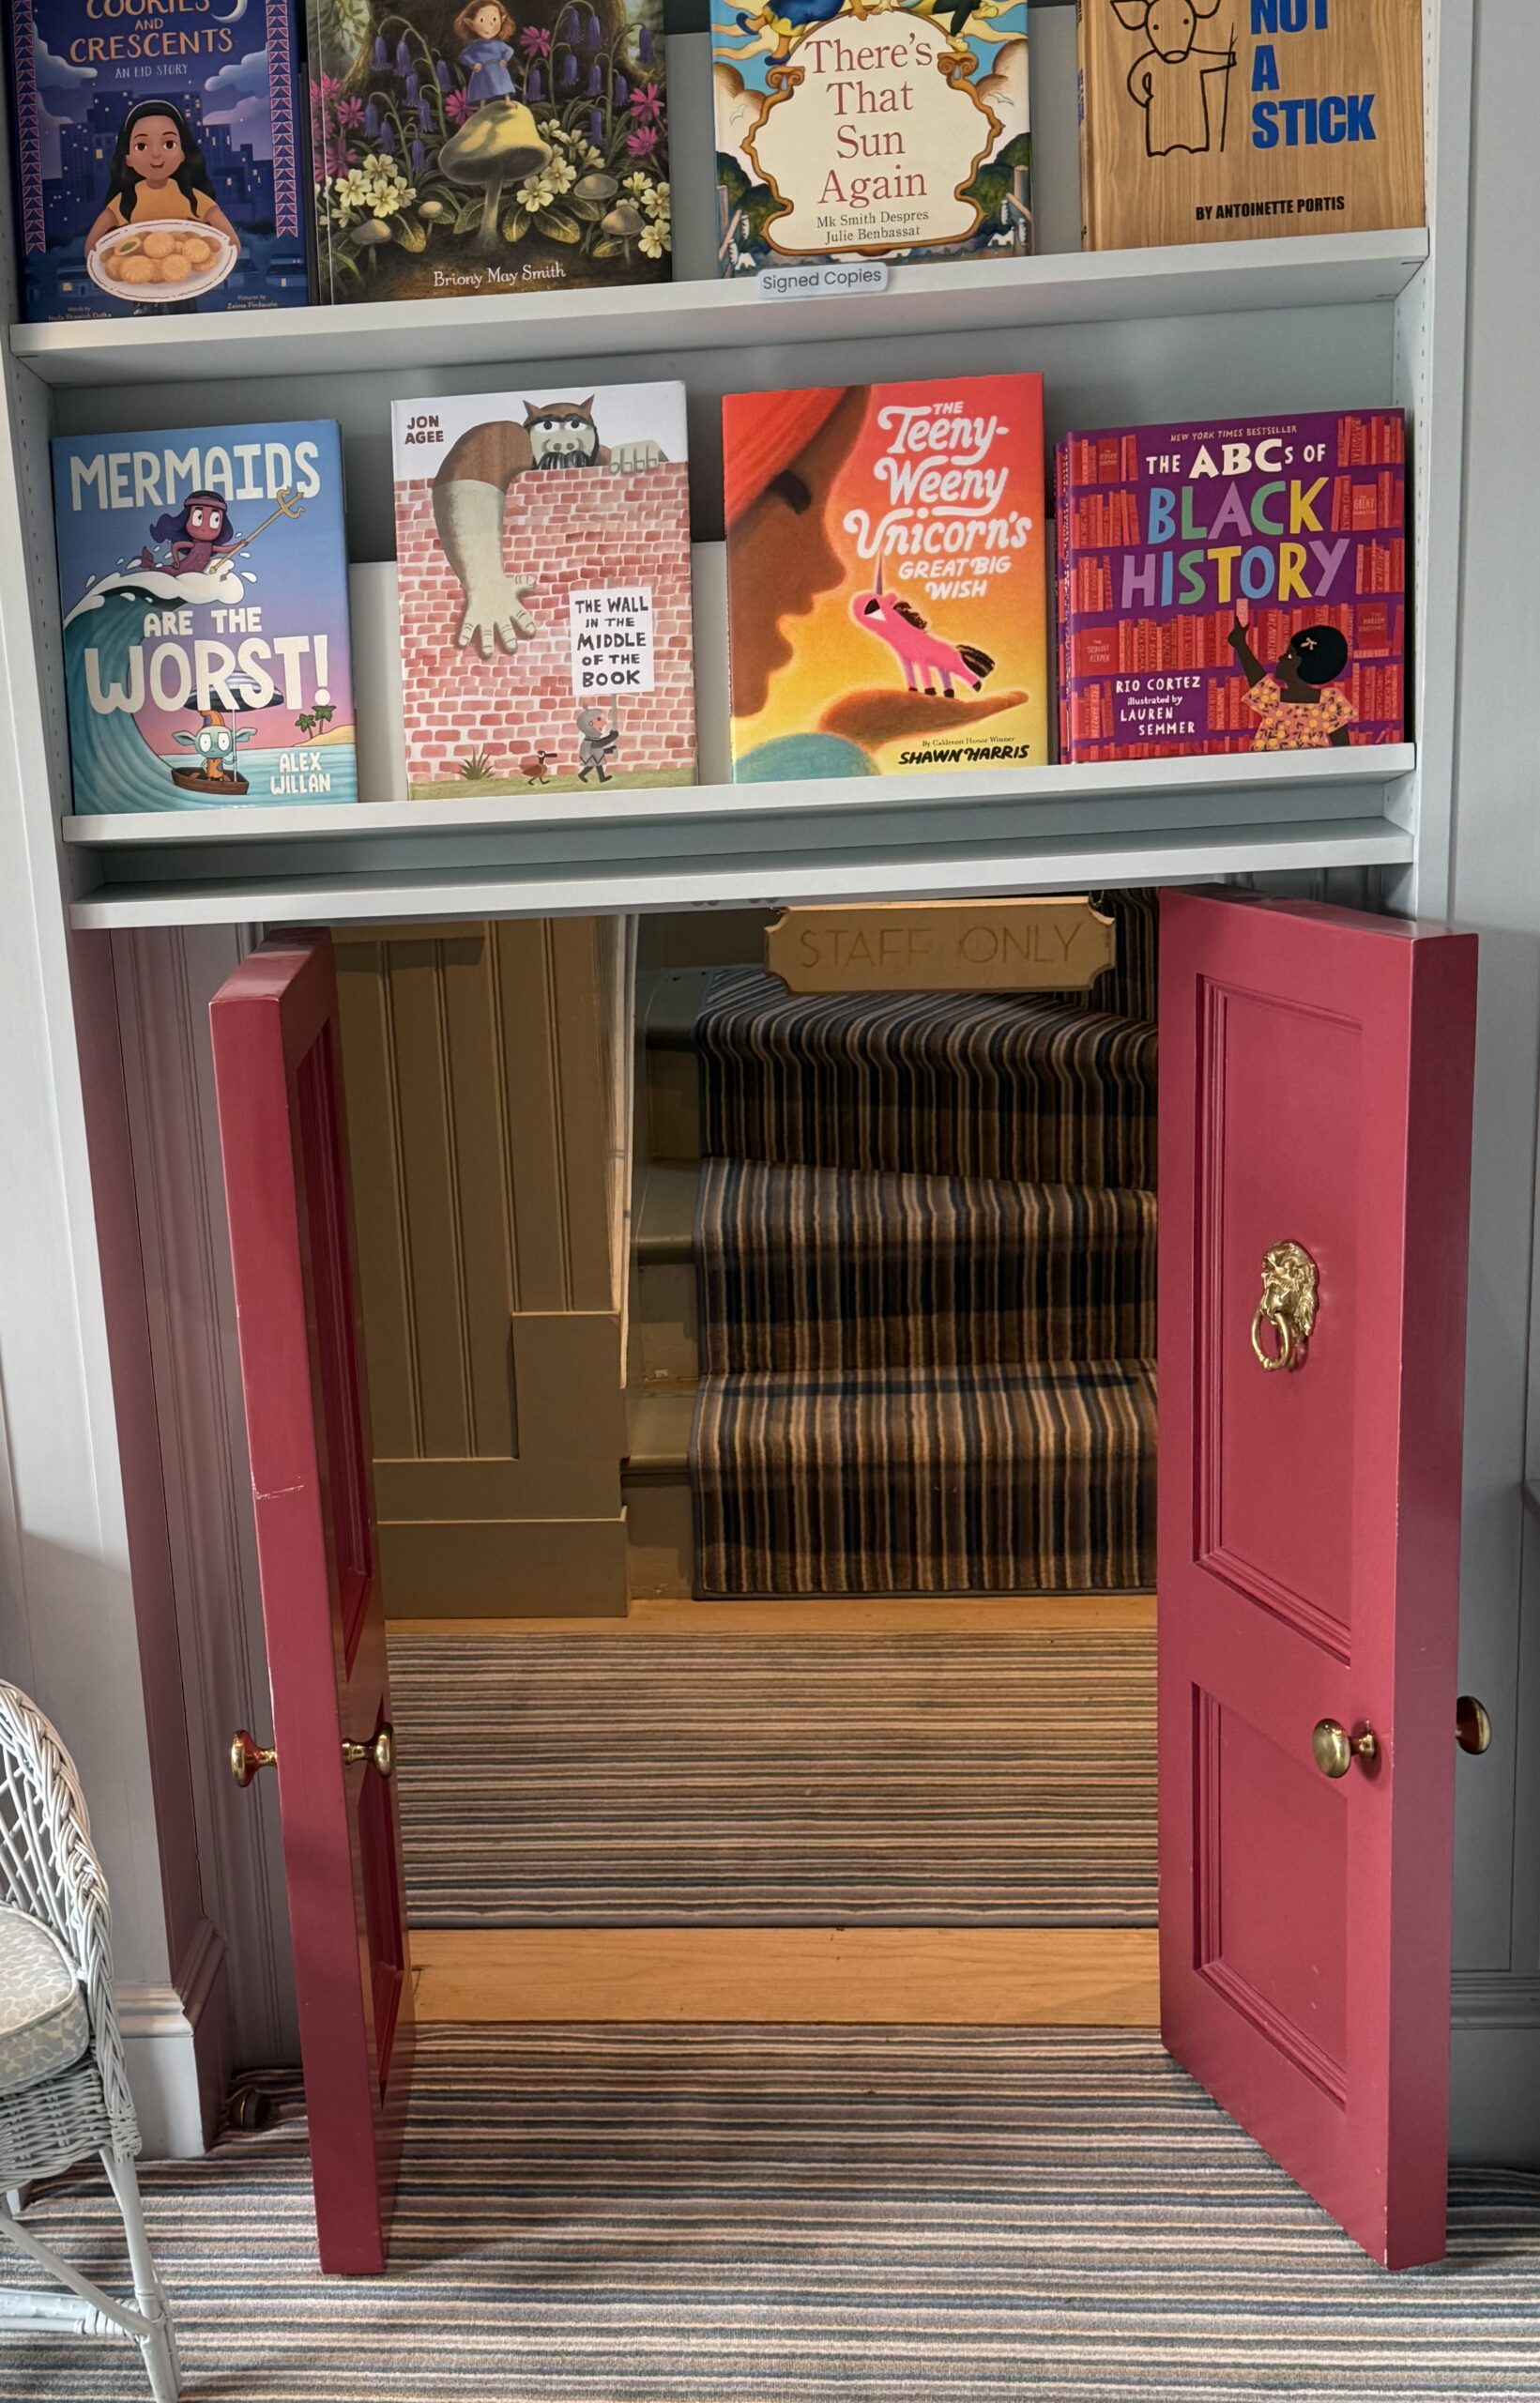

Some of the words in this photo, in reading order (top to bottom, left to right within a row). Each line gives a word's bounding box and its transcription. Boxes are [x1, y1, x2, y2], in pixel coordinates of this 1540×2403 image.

[135, 18, 164, 31] AND
[1251, 0, 1329, 35] NOT
[69, 28, 234, 63] CRESCENTS
[804, 33, 933, 75] There's
[115, 68, 130, 79] AN
[134, 66, 152, 78] EID
[157, 63, 188, 77] STORY
[1251, 44, 1280, 92] A
[826, 81, 914, 115] That
[1251, 94, 1377, 149] STICK
[836, 125, 906, 159] Sun
[817, 164, 928, 208] Again
[816, 216, 836, 228] Mk
[840, 213, 877, 226] Smith
[880, 210, 929, 225] Despres
[1196, 206, 1212, 221] BY
[1215, 199, 1294, 219] ANTOINETTE
[1297, 195, 1345, 215] PORTIS
[825, 231, 854, 245] Julie
[858, 226, 921, 240] Benbassat
[434, 270, 482, 289] Briony
[487, 267, 518, 285] May
[522, 261, 566, 281] Smith
[762, 271, 820, 294] Signed
[824, 268, 881, 288] Copies
[933, 401, 964, 415] THE
[406, 415, 439, 430] JON
[1170, 433, 1189, 443] NEW
[1192, 431, 1215, 440] YORK
[1217, 428, 1243, 438] TIMES
[1246, 425, 1297, 437] BESTSELLER
[404, 430, 444, 445] AGEE
[877, 406, 1011, 466] Teeny-
[1146, 453, 1181, 475] THE
[1303, 444, 1327, 462] OF
[69, 441, 321, 511] MERMAIDS
[874, 456, 1009, 516] Weeny
[1147, 477, 1330, 544] BLACK
[844, 507, 1033, 559] Unicorn's
[898, 558, 969, 580] GREAT
[969, 555, 1012, 576] BIG
[1121, 538, 1351, 609] HISTORY
[925, 579, 988, 601] WISH
[574, 599, 602, 615] THE
[608, 596, 649, 613] WALL
[144, 610, 193, 638] ARE
[211, 606, 263, 634] THE
[586, 618, 600, 628] IN
[604, 617, 635, 628] THE
[576, 632, 647, 650] MIDDLE
[582, 654, 604, 666] OF
[610, 652, 641, 666] THE
[84, 635, 331, 715] WORST!
[582, 669, 641, 688] BOOK
[1116, 679, 1140, 694] RIO
[1147, 676, 1201, 691] CORTEZ
[1127, 695, 1170, 706] illustrated
[1171, 694, 1182, 706] by
[1121, 707, 1173, 722] LAUREN
[1138, 722, 1196, 737] SEMMER
[279, 752, 322, 773] ALEX
[898, 748, 960, 766] SHAWN
[960, 744, 1030, 761] HARRIS
[270, 773, 331, 796] WILLAN
[800, 928, 932, 969] STAFF
[959, 923, 1082, 964] ONLY
